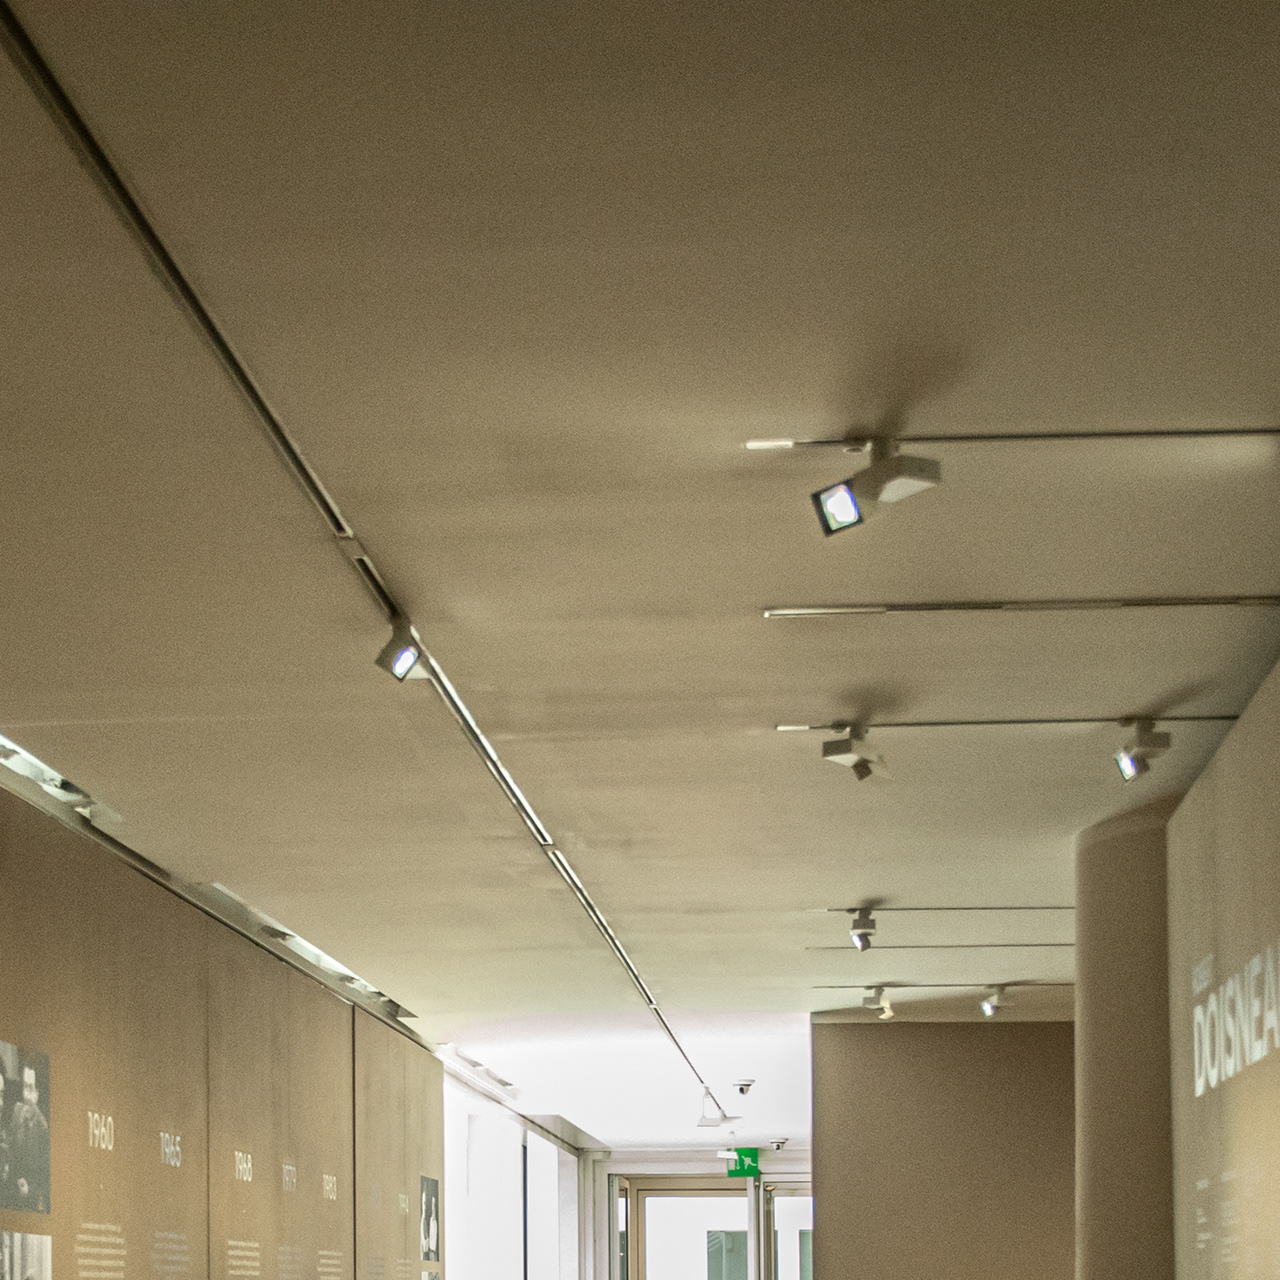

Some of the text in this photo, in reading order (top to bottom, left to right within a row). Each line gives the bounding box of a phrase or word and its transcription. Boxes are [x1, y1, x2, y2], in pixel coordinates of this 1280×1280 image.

[86, 1110, 115, 1151] 1960
[159, 1131, 183, 1168] 1965
[234, 1150, 253, 1183] 1968
